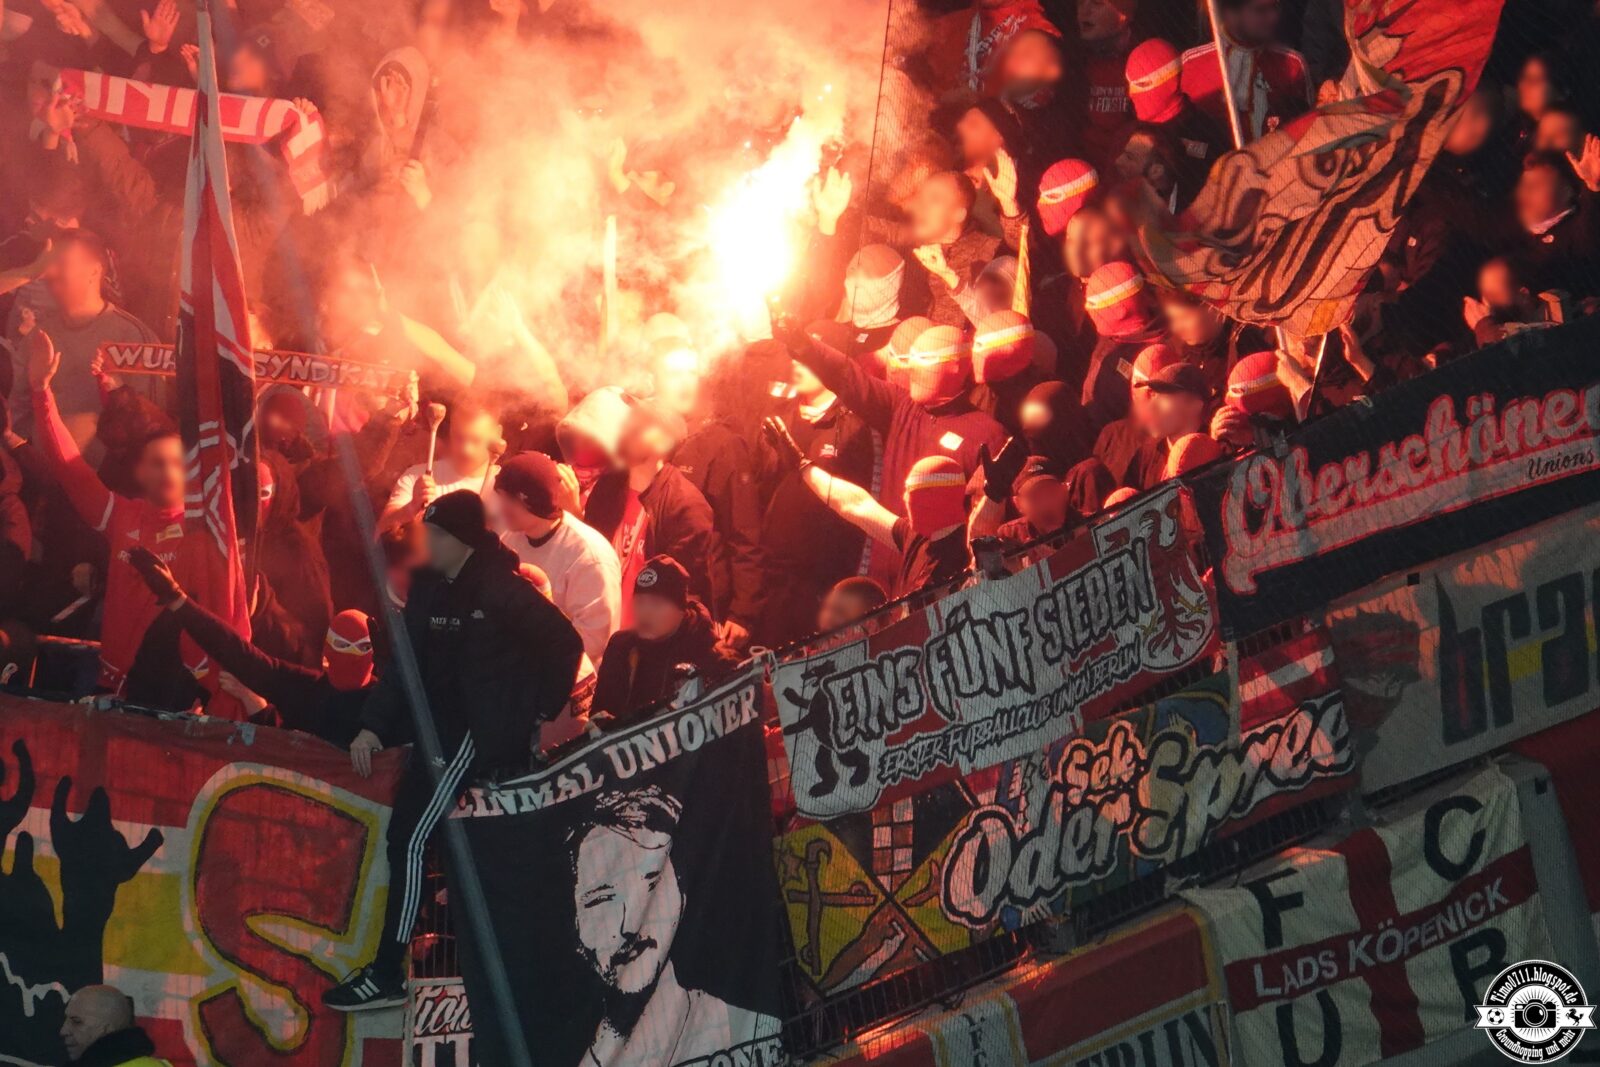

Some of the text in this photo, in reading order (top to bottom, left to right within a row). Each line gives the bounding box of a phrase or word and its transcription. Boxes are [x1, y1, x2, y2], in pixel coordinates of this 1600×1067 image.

[1222, 384, 1600, 562] Oberschöne
[825, 539, 1153, 747] EINS FÜNF SIEBEN
[878, 736, 950, 785] ERSTER
[1052, 662, 1094, 718] UNION
[1092, 631, 1141, 703] BERLIN
[603, 685, 758, 780] UNIONER
[944, 694, 1355, 927] Oder Spree
[1424, 795, 1486, 882] C
[1254, 877, 1510, 998] LADS KÖPENICK
